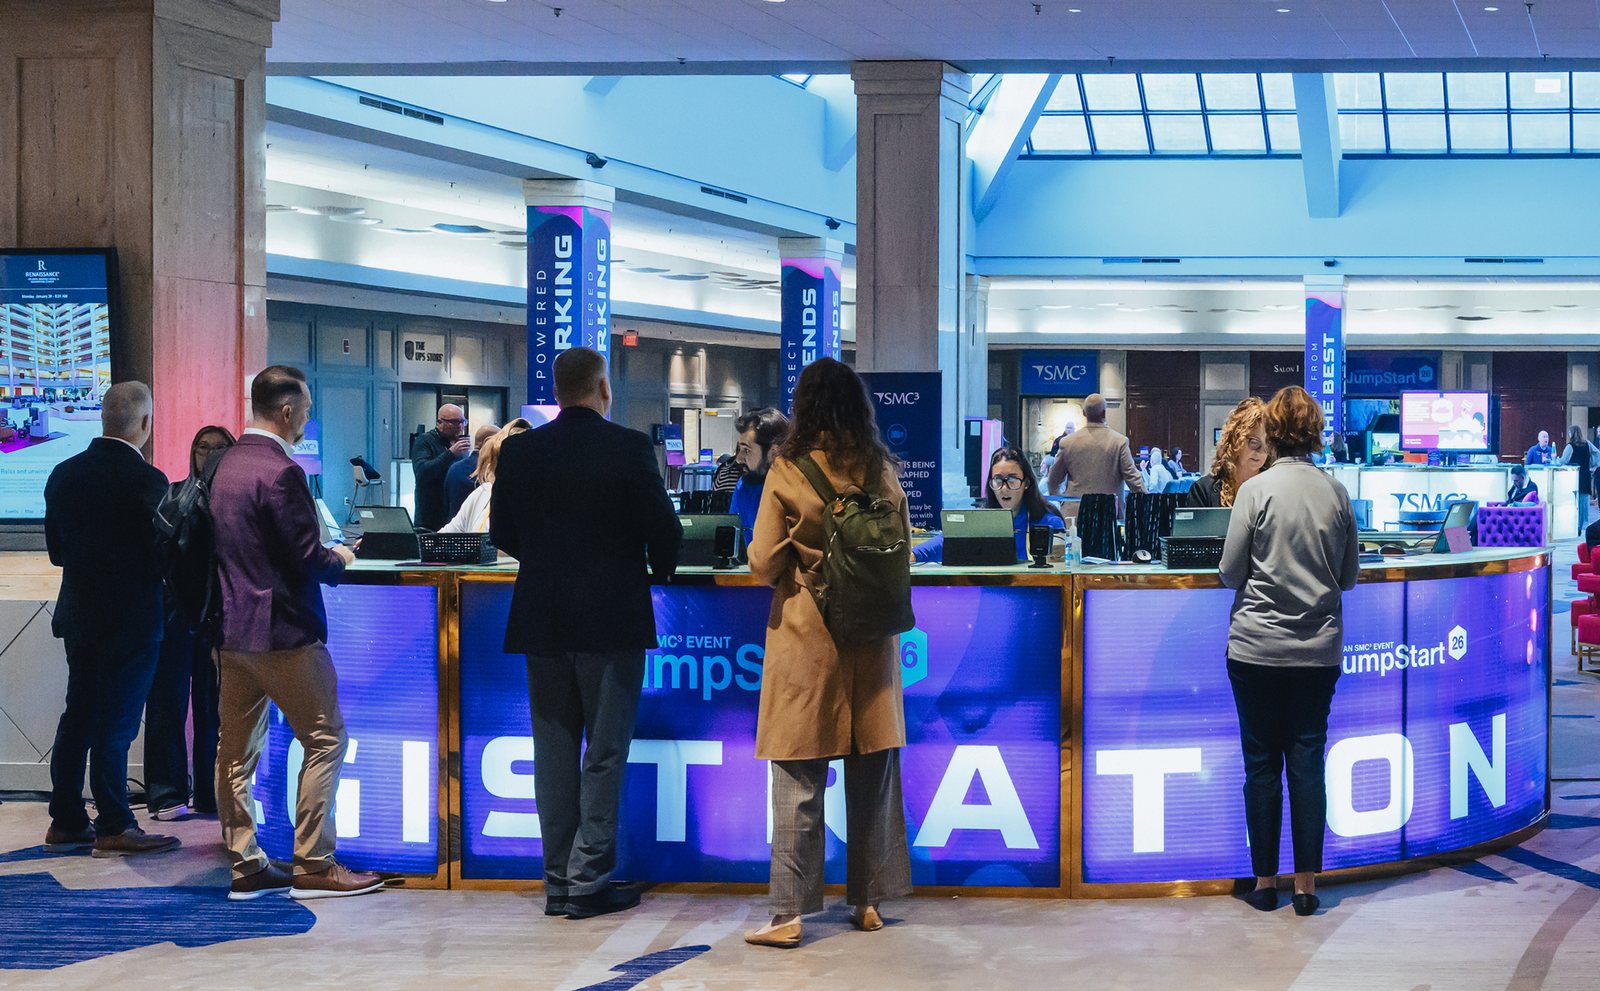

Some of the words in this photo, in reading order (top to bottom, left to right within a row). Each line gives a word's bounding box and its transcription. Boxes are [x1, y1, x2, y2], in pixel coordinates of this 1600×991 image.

[415, 341, 426, 351] THE
[415, 351, 426, 362] UPS
[1310, 343, 1319, 381] FROM
[1322, 332, 1335, 395] BEST
[912, 461, 936, 469] BEING
[686, 635, 732, 649] EVENT
[1373, 641, 1395, 651] EVENT
[1451, 635, 1465, 650] 26
